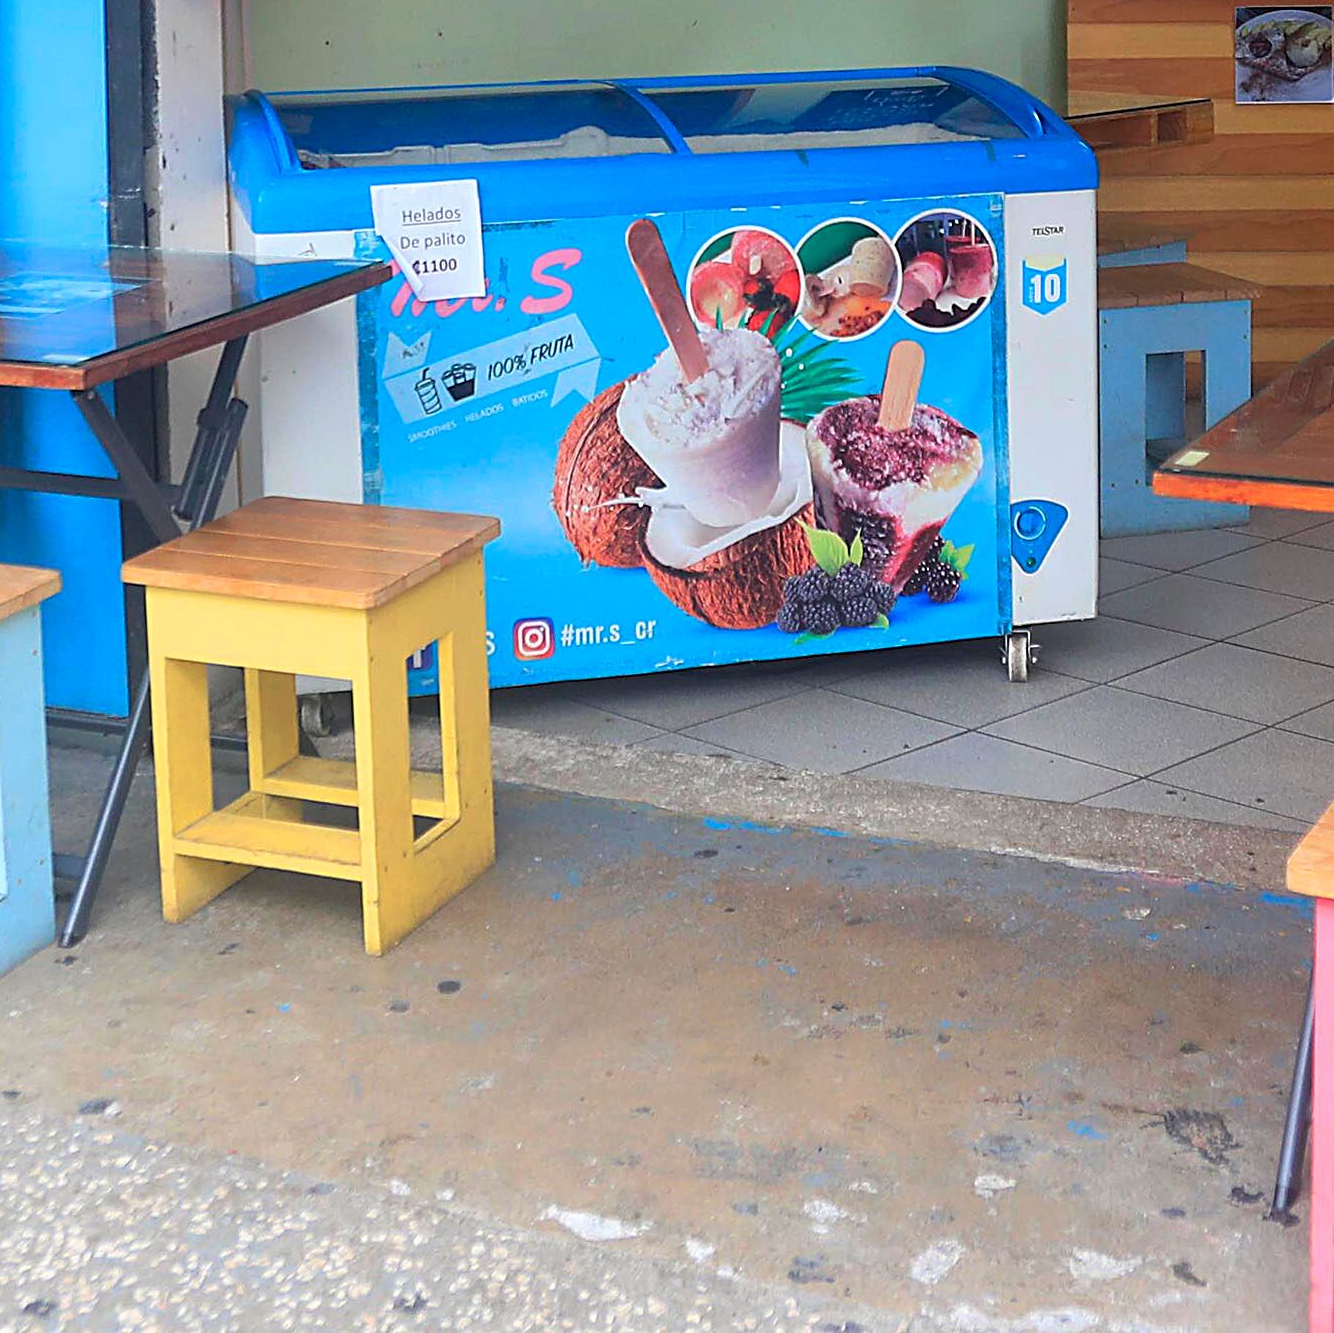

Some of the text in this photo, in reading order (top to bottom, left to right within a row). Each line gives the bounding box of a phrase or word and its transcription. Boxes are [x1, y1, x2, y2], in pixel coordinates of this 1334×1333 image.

[402, 207, 461, 223] Helados
[400, 233, 466, 251] De palito
[1032, 226, 1064, 236] TELSTAR
[520, 248, 582, 314] S
[1030, 273, 1061, 303] 10
[487, 334, 574, 381] 100% FRUTA
[407, 389, 548, 443] SMOOTHIES HELADOS BATIDOS
[561, 620, 657, 648] #mr.s_cr
